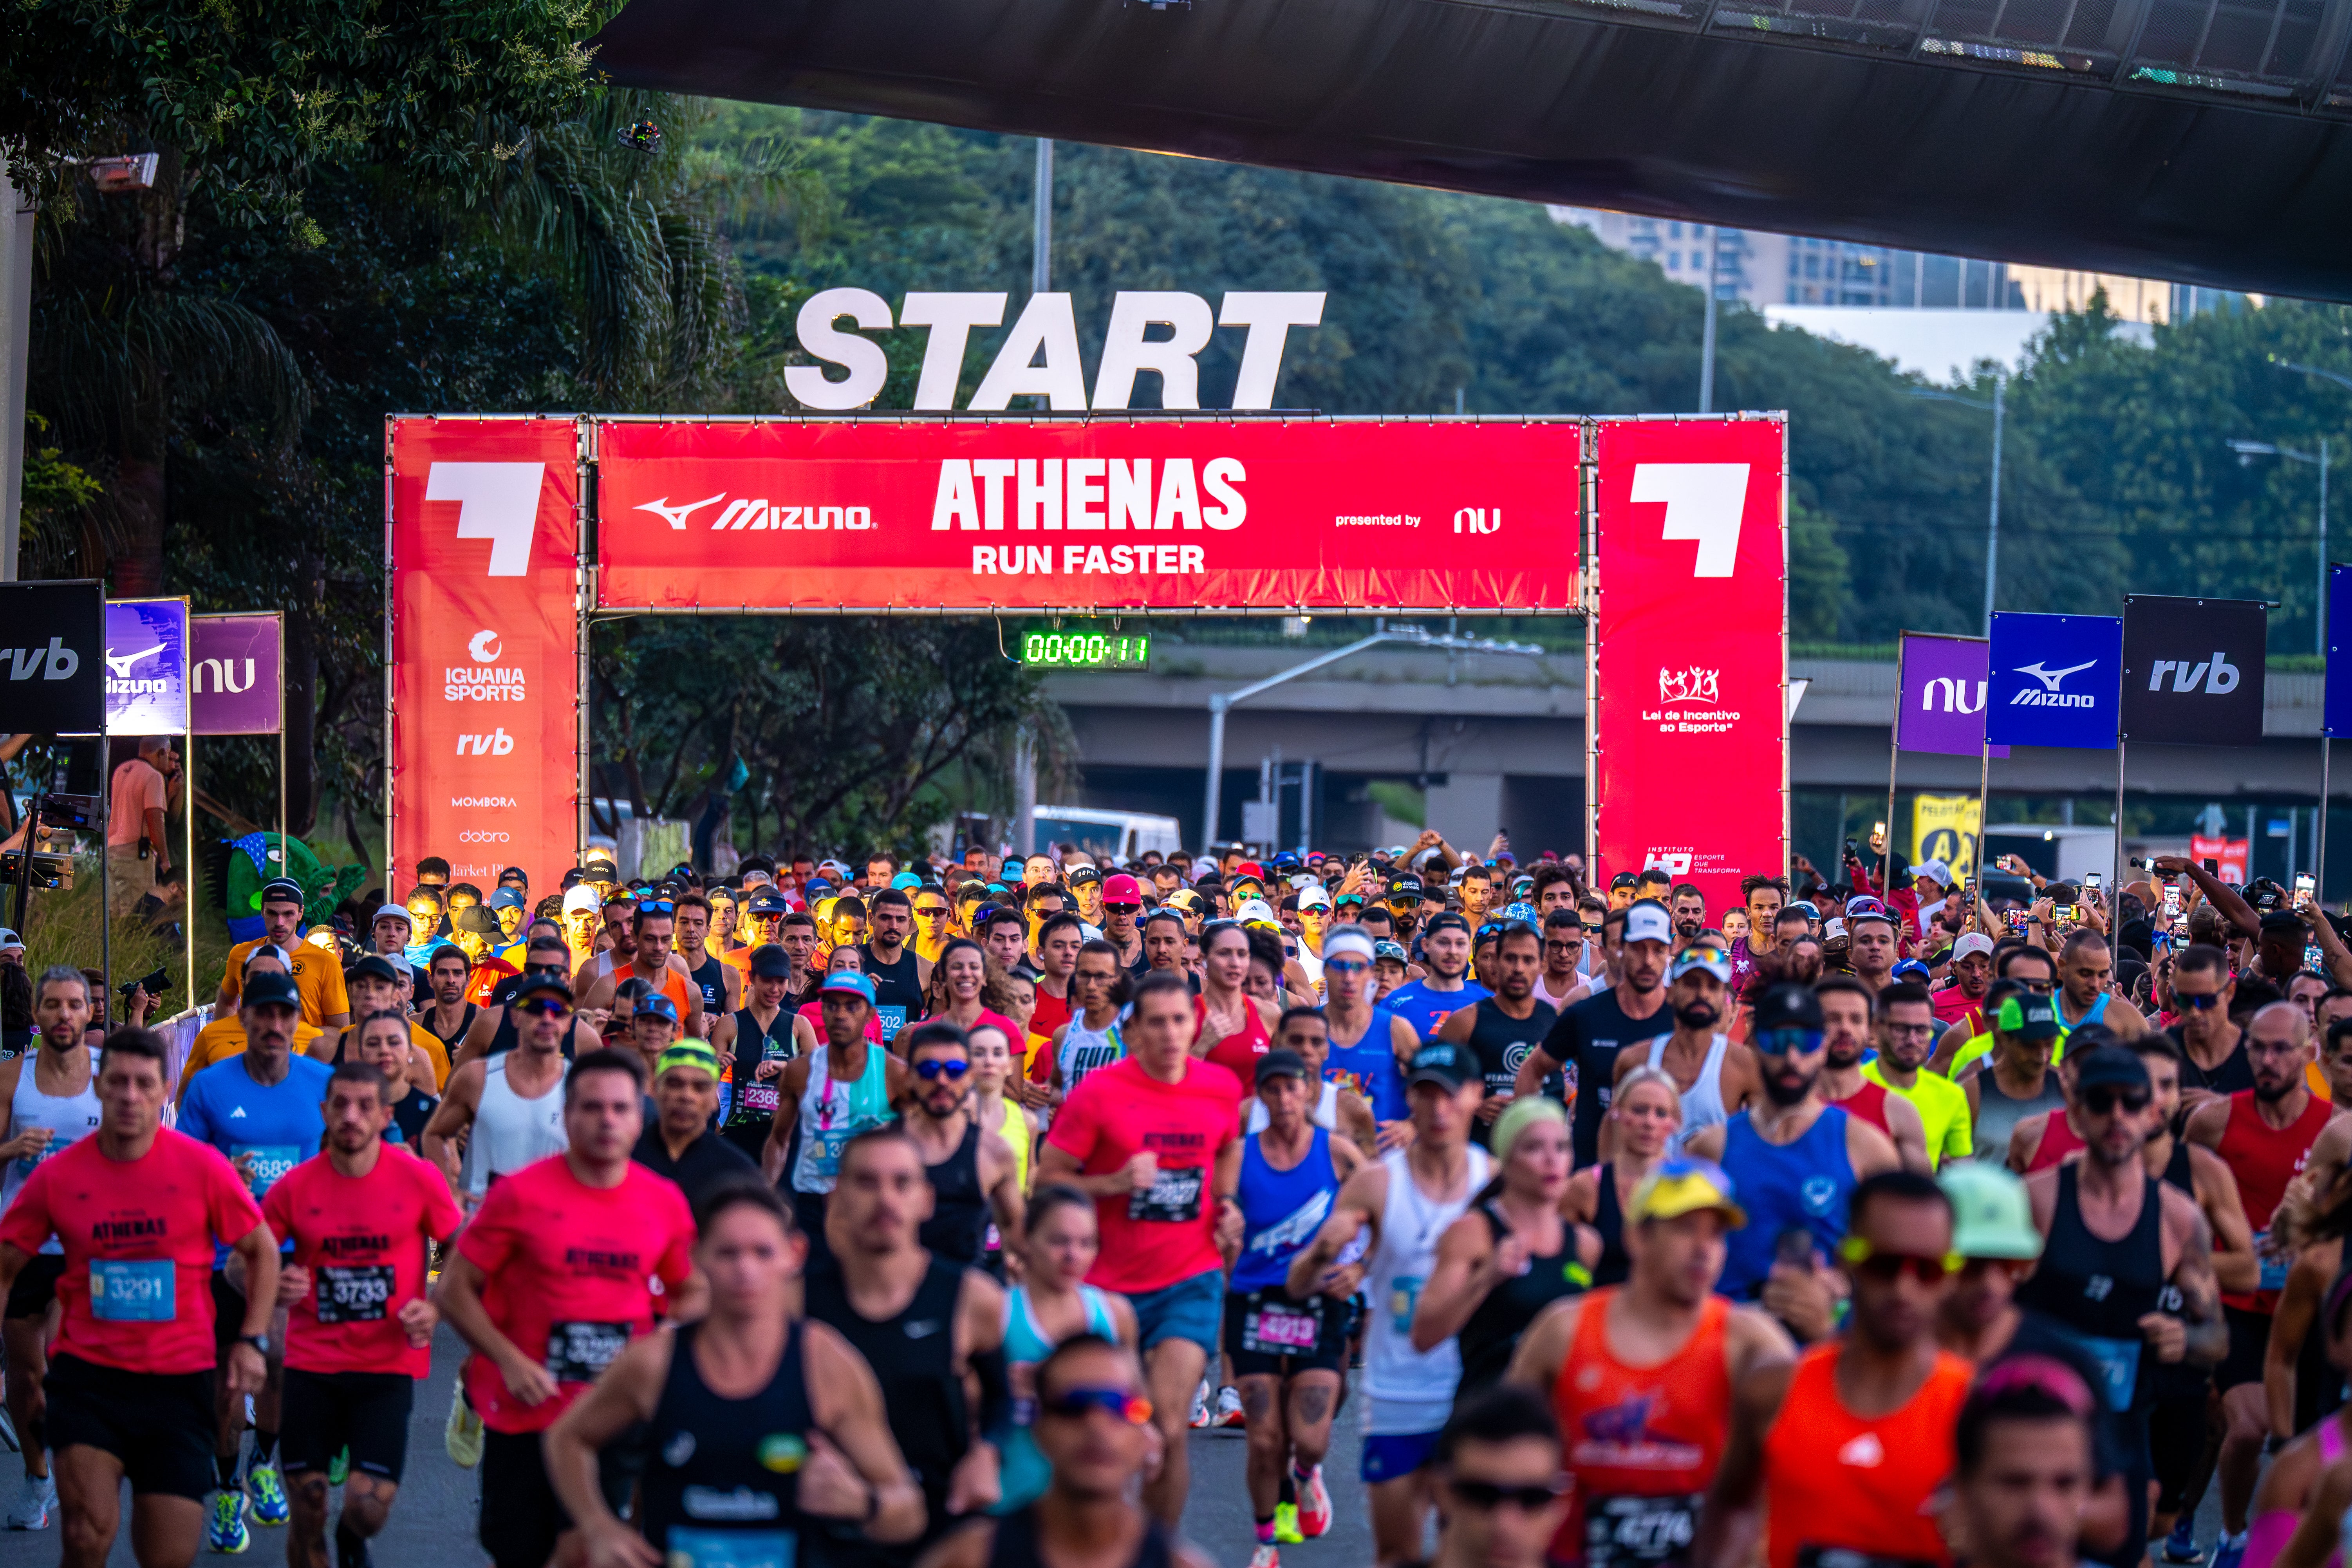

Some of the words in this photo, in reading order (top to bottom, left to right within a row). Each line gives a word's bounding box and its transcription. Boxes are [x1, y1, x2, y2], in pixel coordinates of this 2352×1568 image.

[784, 287, 1327, 411] START
[931, 457, 1246, 530] ATHENAS
[1335, 514, 1402, 527] presented
[1405, 515, 1421, 528] by
[973, 546, 1052, 575] RUN
[1064, 545, 1205, 574] FASTER
[1026, 634, 1146, 663] 00:00:11
[446, 668, 525, 684] IGUANA
[2148, 652, 2240, 694] rvb
[106, 676, 167, 694] IZUNO
[444, 685, 525, 701] SPORTS
[1642, 710, 1661, 720] Lei
[1665, 710, 1680, 720] de
[1684, 710, 1740, 720] Incentivo
[1660, 724, 1675, 732] ao
[1678, 722, 1727, 734] Esporte
[457, 727, 514, 755] rvb
[452, 797, 517, 807] MOMBORA
[459, 829, 510, 843] dobro
[879, 1015, 900, 1028] 502
